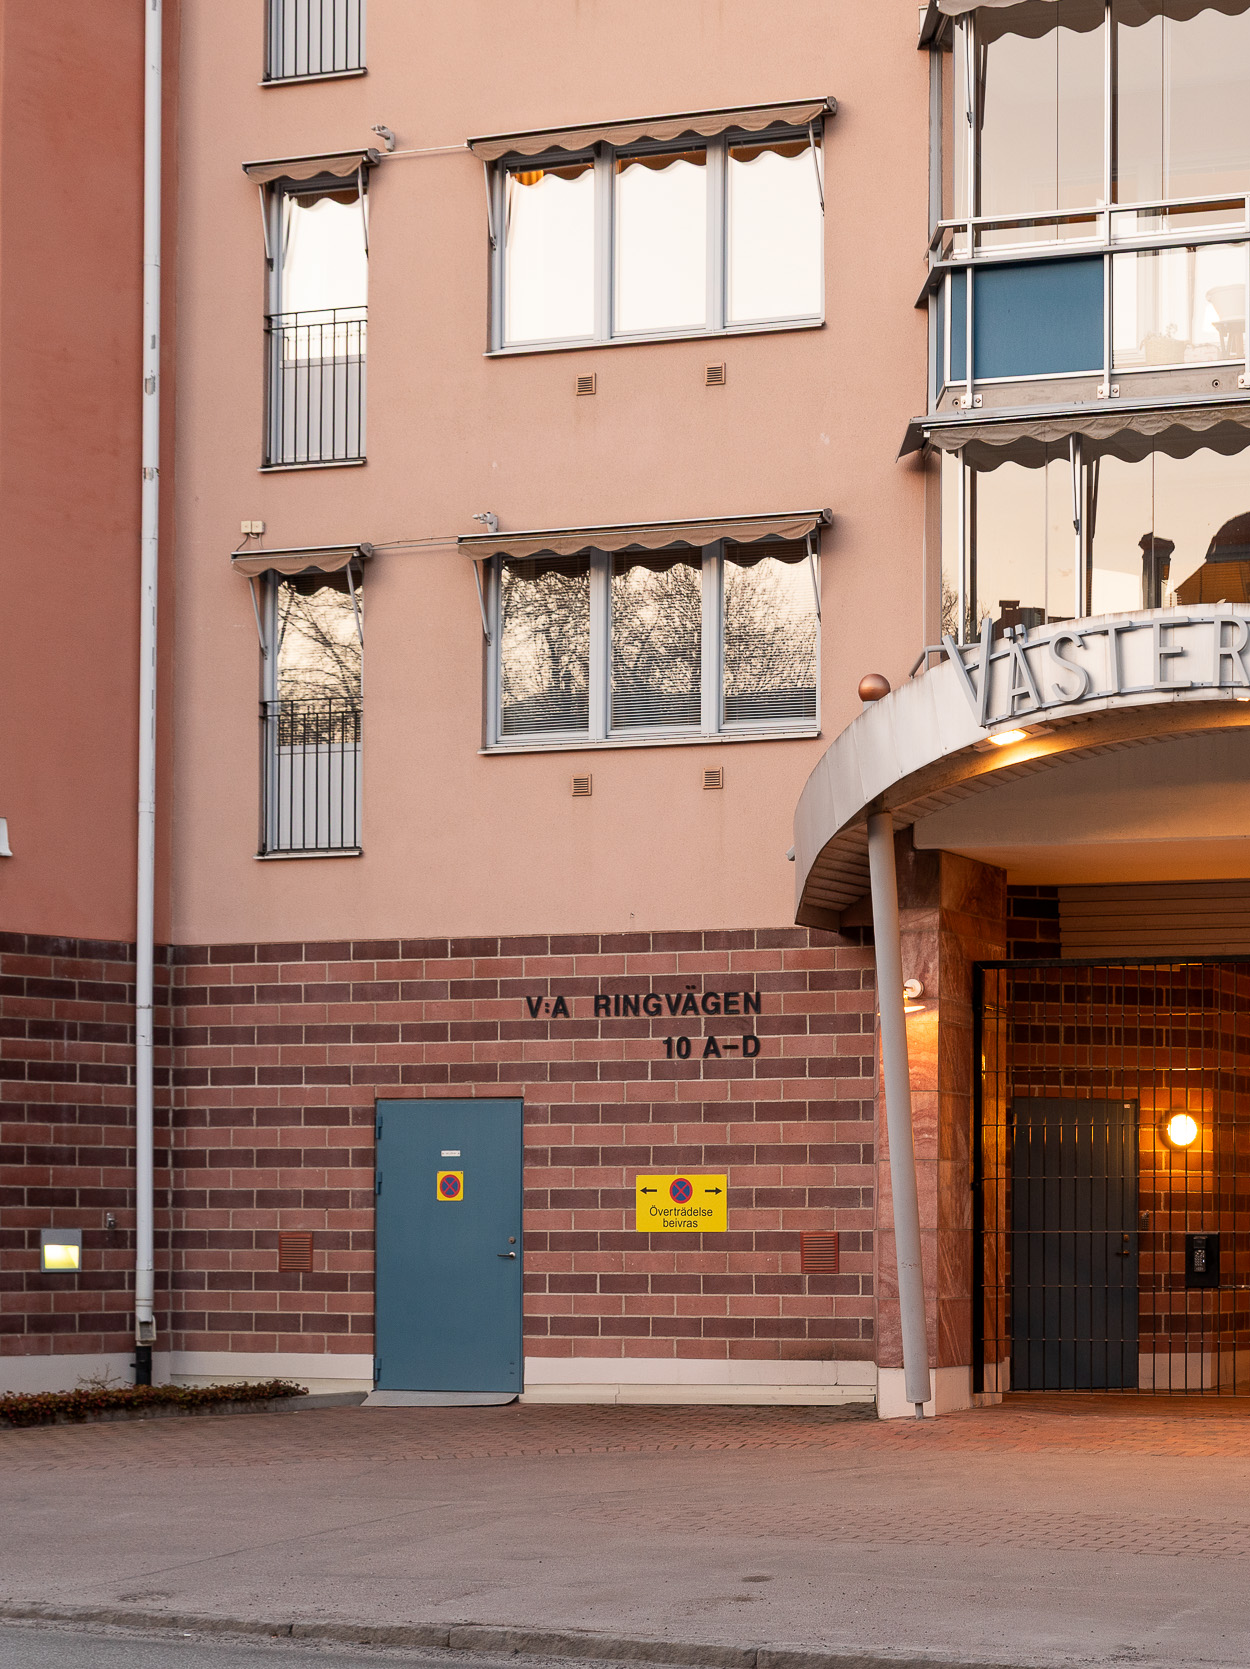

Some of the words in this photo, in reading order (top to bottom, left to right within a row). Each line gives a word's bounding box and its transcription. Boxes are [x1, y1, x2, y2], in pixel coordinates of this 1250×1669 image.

[526, 995, 570, 1018] V:A
[594, 984, 762, 1018] RINGVÄGEN
[662, 1036, 692, 1059] 10
[649, 1205, 713, 1217] Överträdelse
[662, 1218, 698, 1228] beivras
